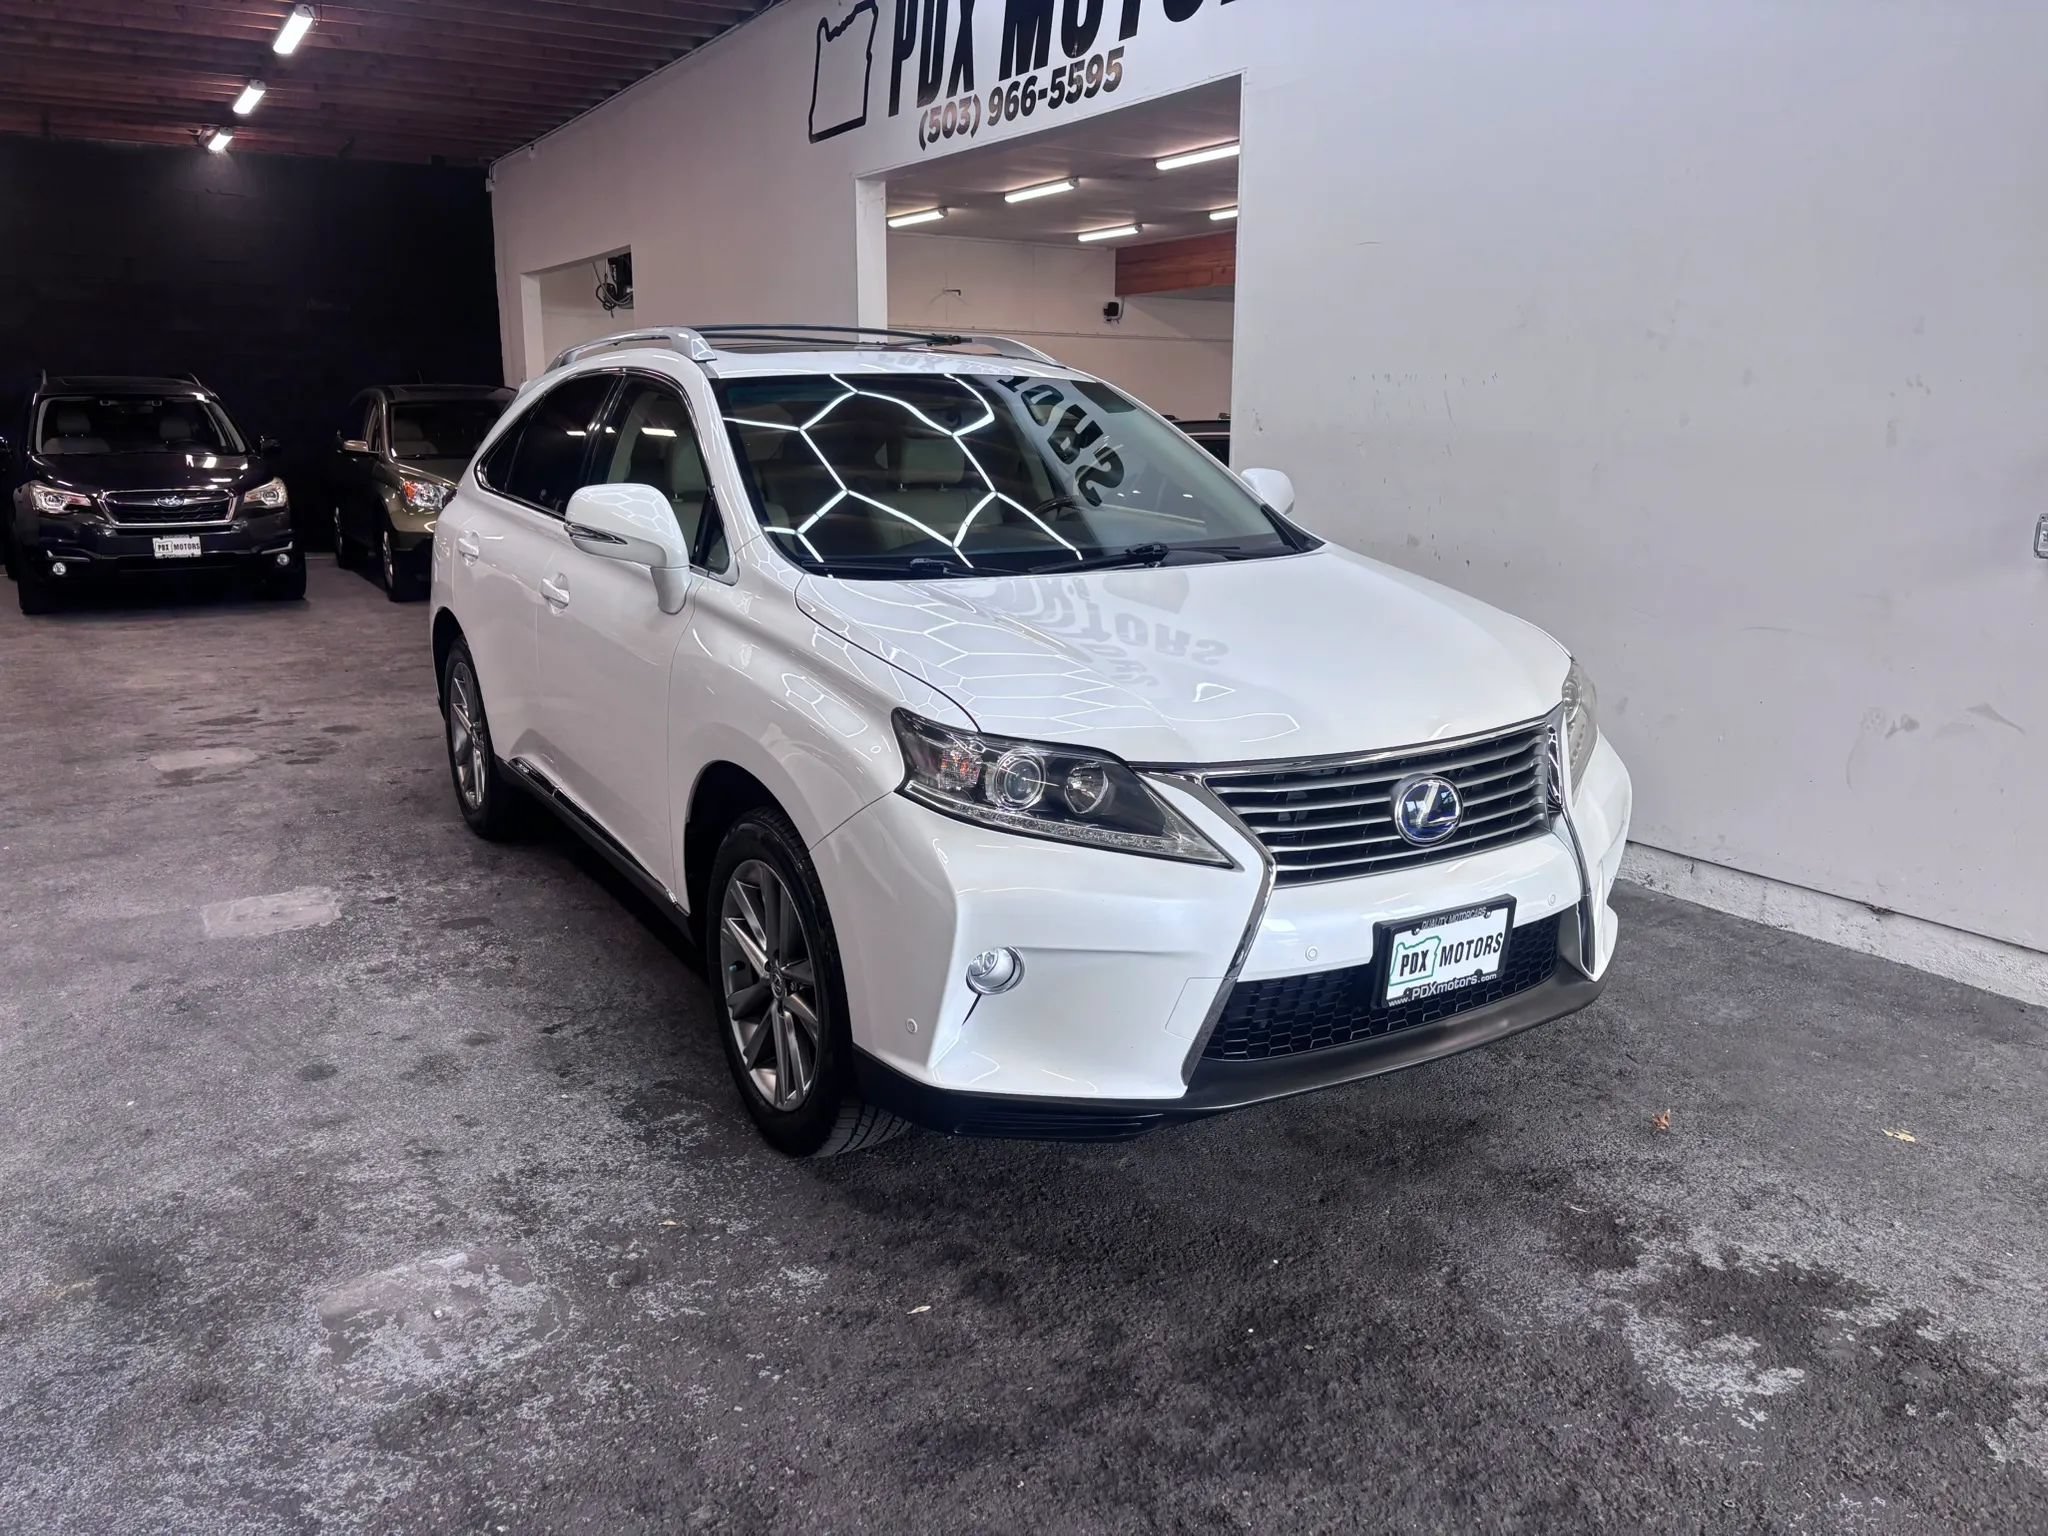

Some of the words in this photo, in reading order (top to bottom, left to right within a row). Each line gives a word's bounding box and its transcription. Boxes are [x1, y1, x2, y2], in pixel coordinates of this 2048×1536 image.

[918, 94, 981, 151] (503)
[987, 46, 1125, 127] 966-5595
[1400, 949, 1429, 977] PDX
[1439, 932, 1503, 967] MOTORS
[1388, 973, 1497, 1007] www.PDXmotors.com
